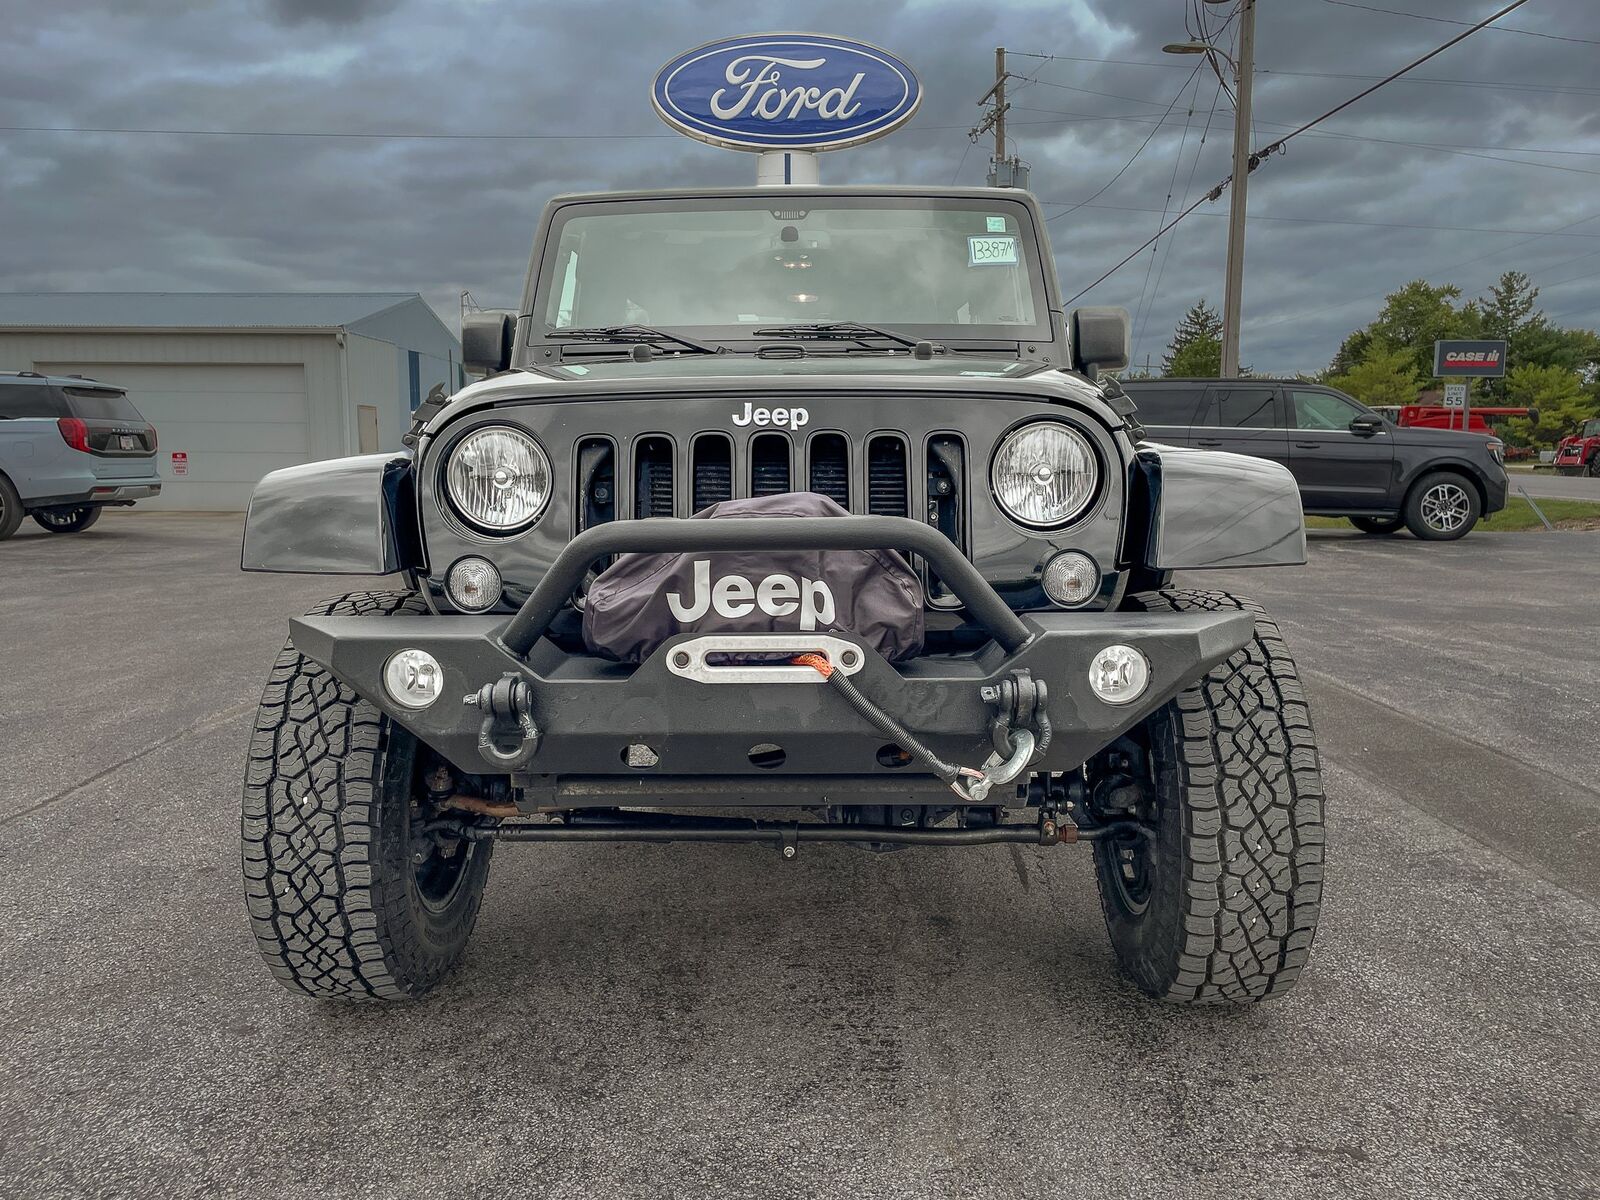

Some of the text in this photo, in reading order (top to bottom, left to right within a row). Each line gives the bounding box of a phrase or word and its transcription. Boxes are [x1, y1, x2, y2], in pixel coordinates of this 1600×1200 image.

[710, 55, 866, 120] Ford
[1446, 351, 1485, 361] CASE
[1446, 396, 1463, 406] 55
[731, 402, 809, 431] Jeep
[666, 559, 836, 631] Jeep
